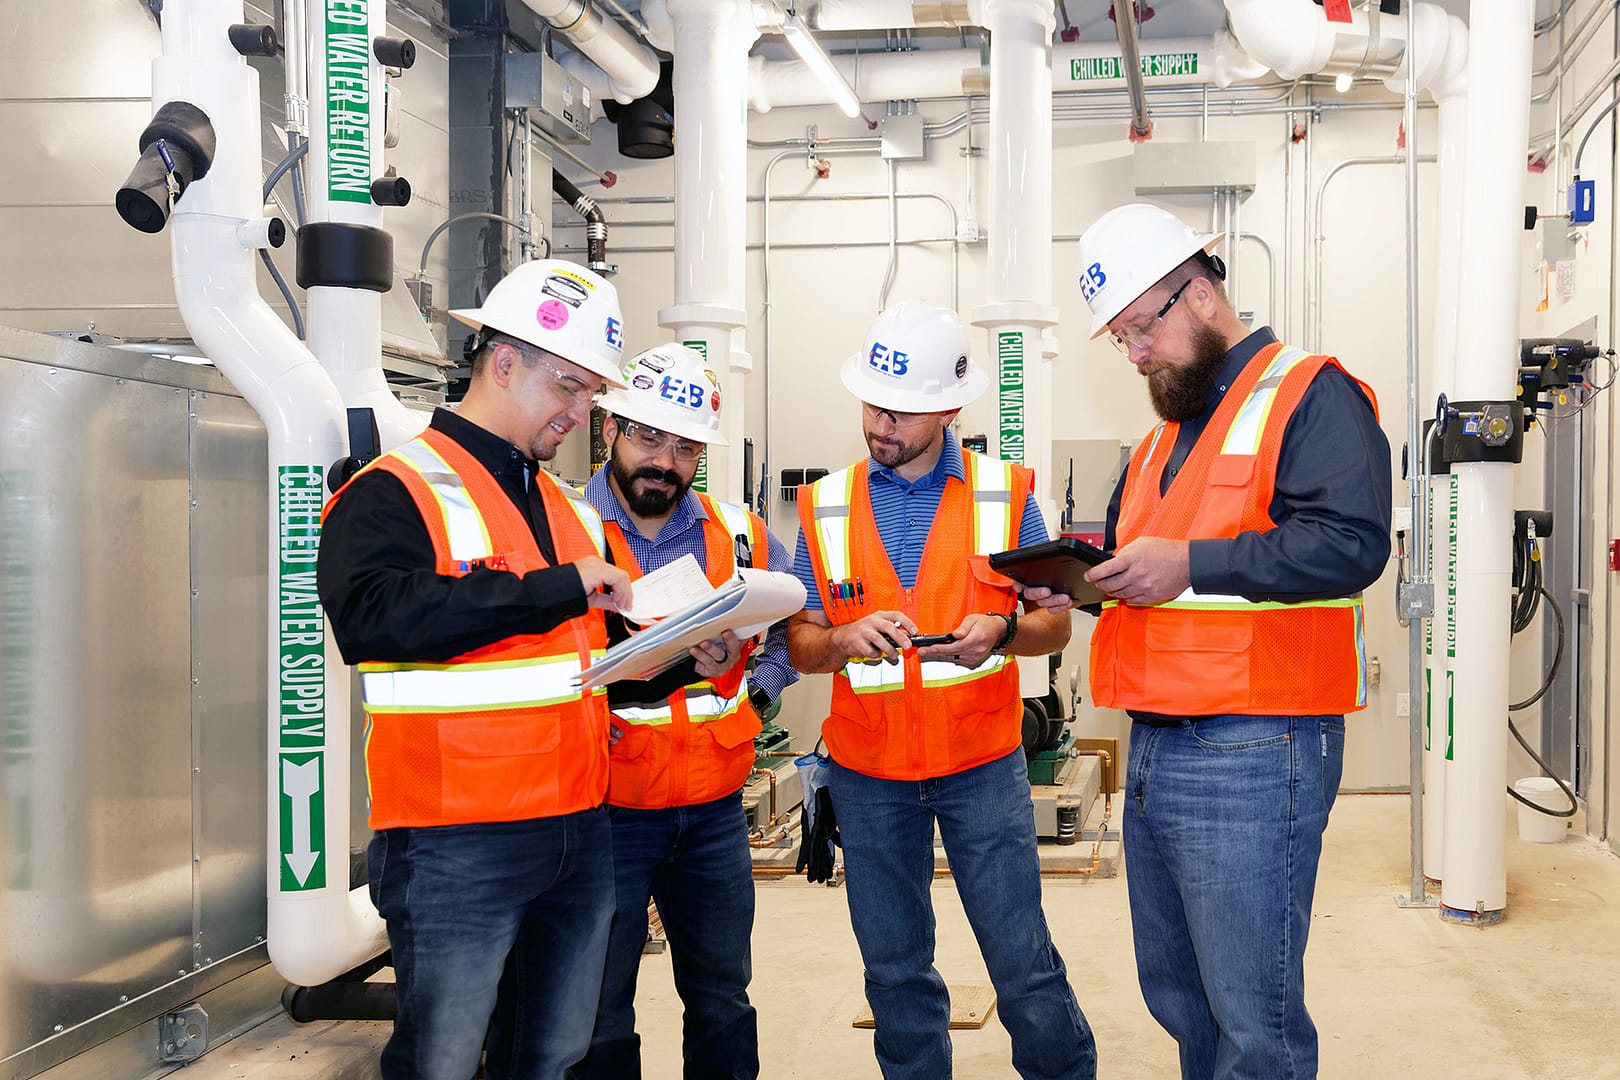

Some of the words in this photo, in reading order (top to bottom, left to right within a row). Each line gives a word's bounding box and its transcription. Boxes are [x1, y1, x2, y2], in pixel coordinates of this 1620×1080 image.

[328, 33, 369, 104] WATER
[1073, 58, 1115, 80] CHILLED
[1117, 56, 1153, 78] WER
[1154, 54, 1195, 76] SUPPLY
[329, 109, 371, 194] RETURN
[869, 342, 909, 376] EAB
[1000, 335, 1022, 386] CHILLED
[659, 375, 705, 408] EAB
[1000, 389, 1023, 431] WATER
[1001, 434, 1024, 465] SUP
[279, 472, 323, 564] CHILLED
[280, 570, 323, 647] WATER
[281, 653, 324, 737] SUPPLY
